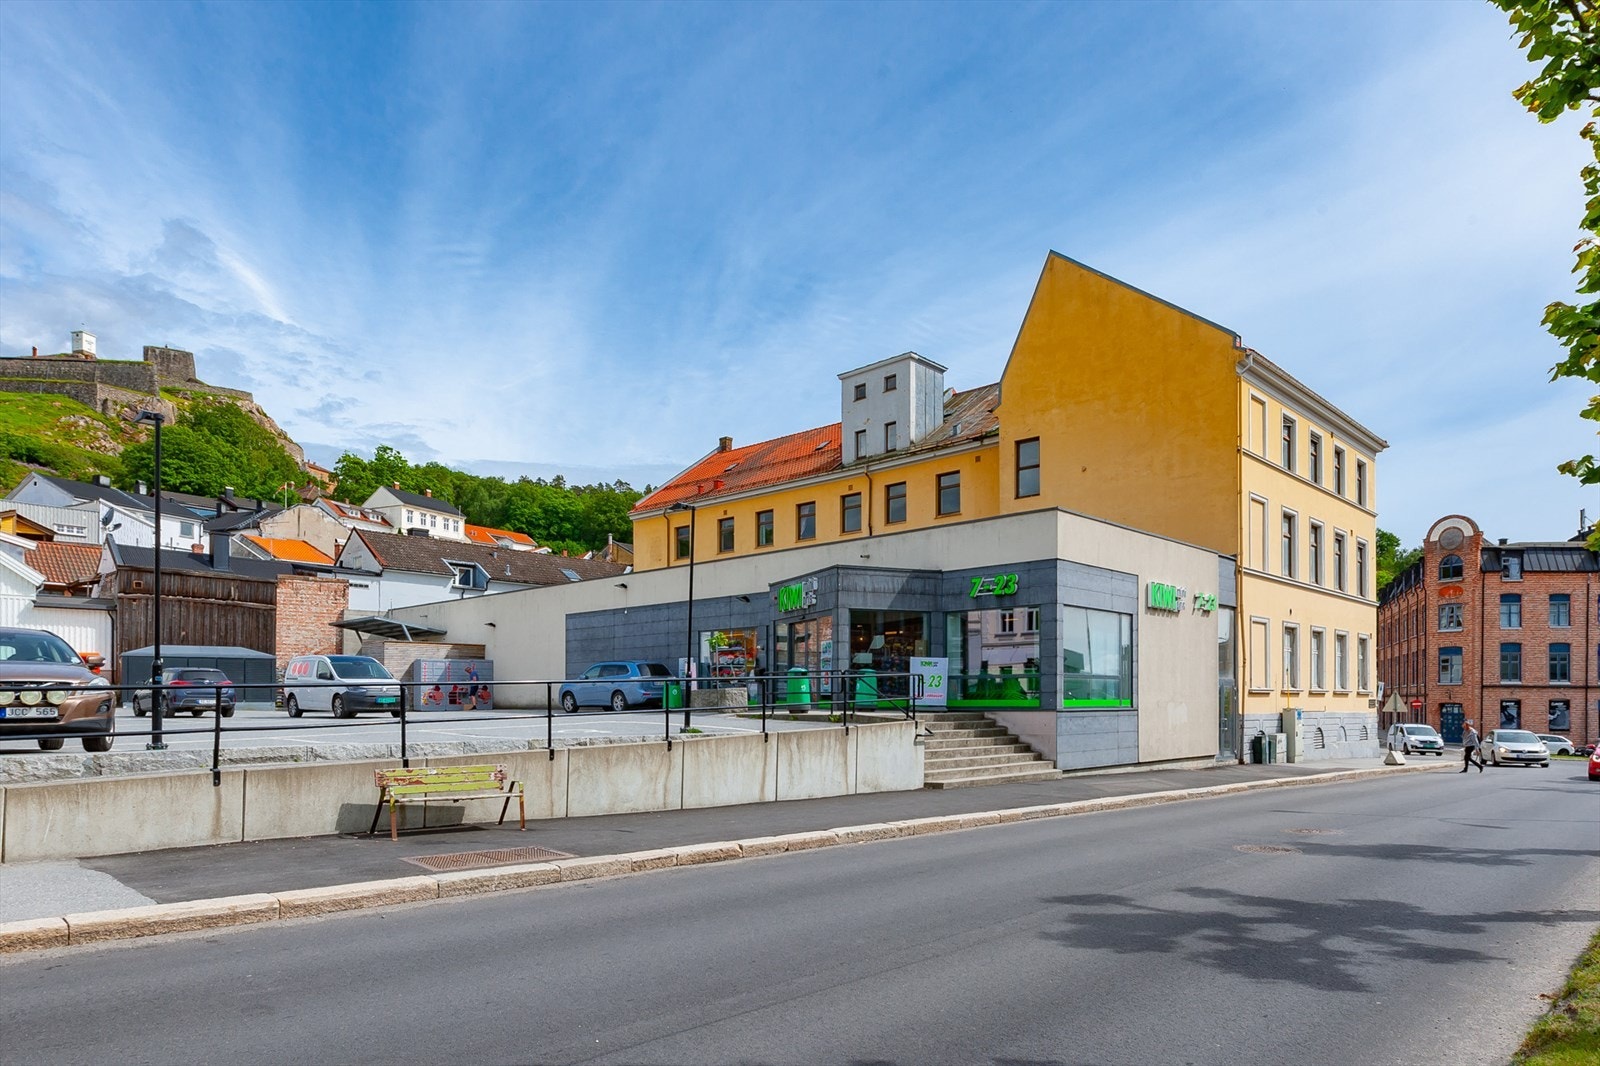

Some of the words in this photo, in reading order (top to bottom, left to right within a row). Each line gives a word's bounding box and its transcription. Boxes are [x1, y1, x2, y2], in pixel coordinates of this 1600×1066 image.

[778, 582, 802, 612] KIWI
[970, 574, 1018, 597] 7-23
[1149, 581, 1177, 611] KIWI
[8, 708, 28, 716] JCC
[35, 708, 56, 716] 565
